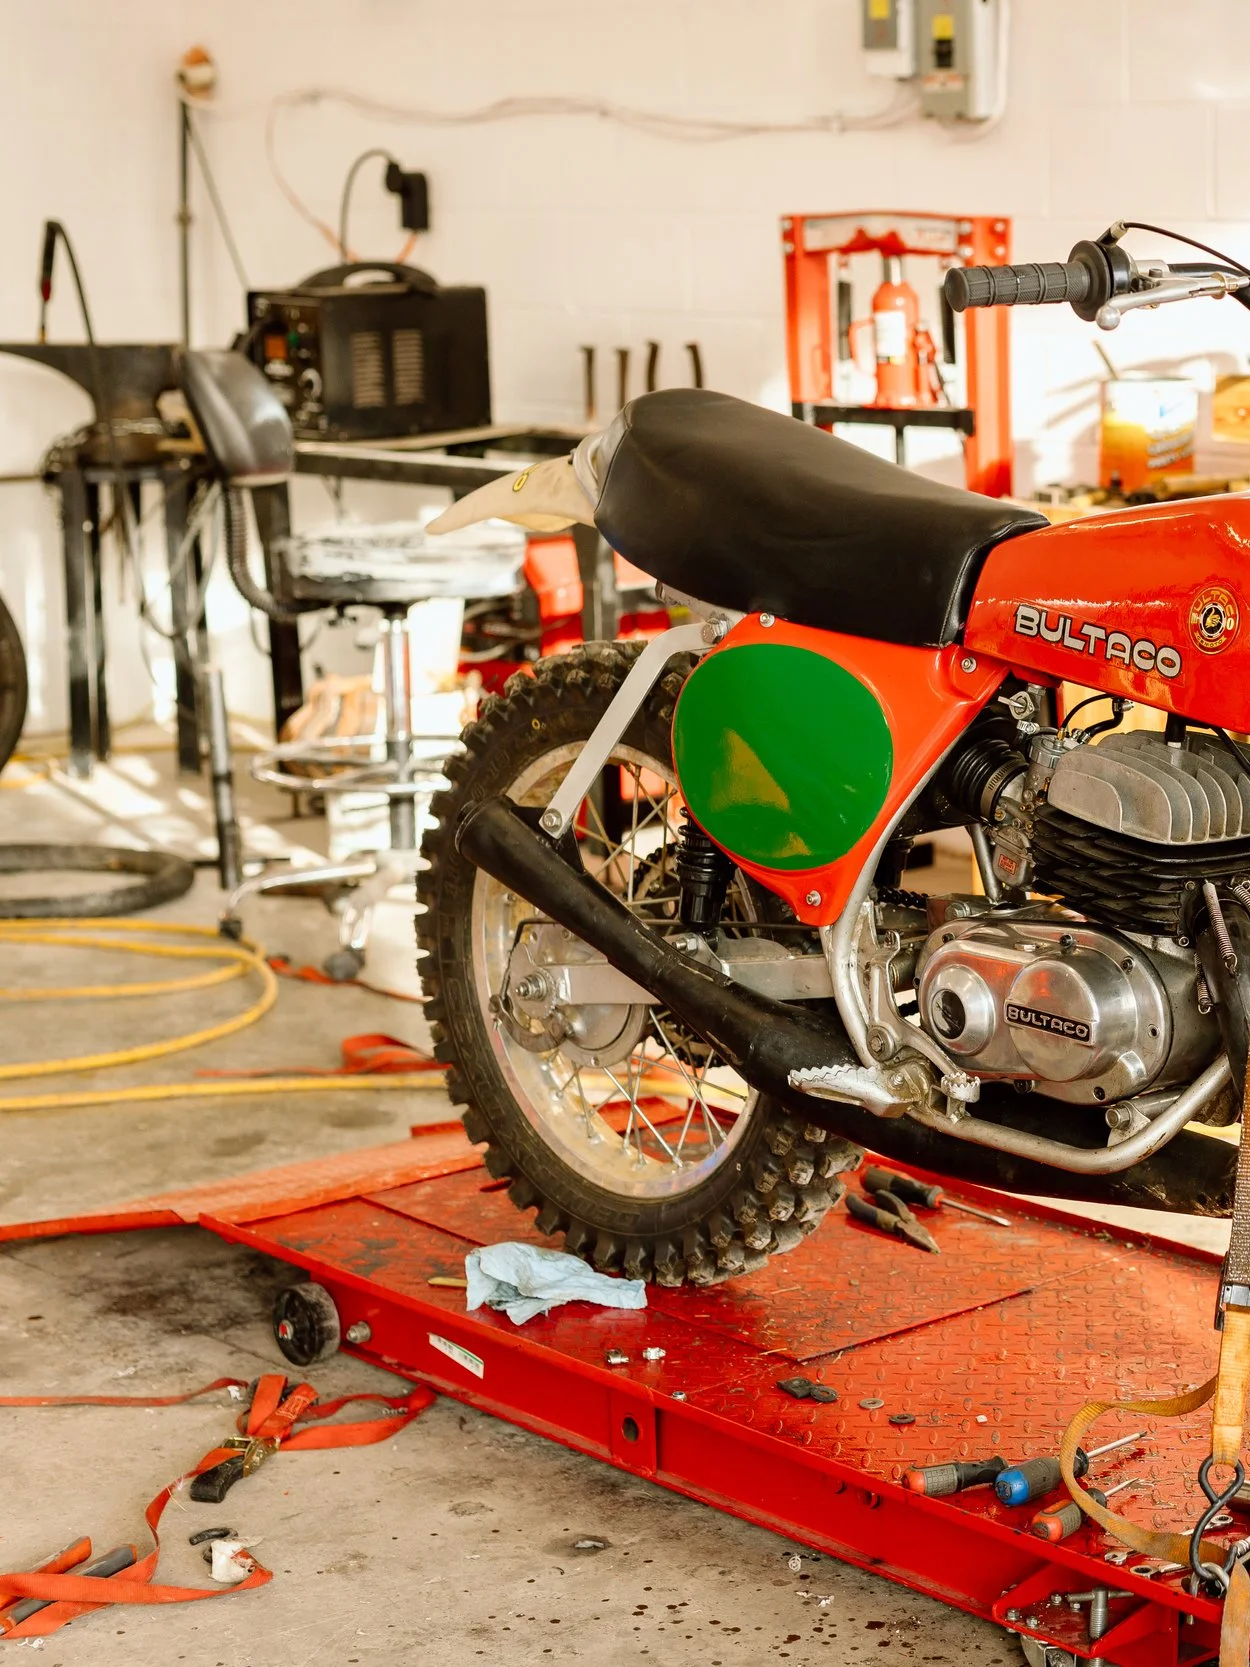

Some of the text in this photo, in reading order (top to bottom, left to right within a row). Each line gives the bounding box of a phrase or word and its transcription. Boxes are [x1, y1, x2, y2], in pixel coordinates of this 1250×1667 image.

[1190, 590, 1235, 631] BULTACO
[1013, 603, 1183, 679] BULTACO
[1007, 1006, 1089, 1039] BULTACO
